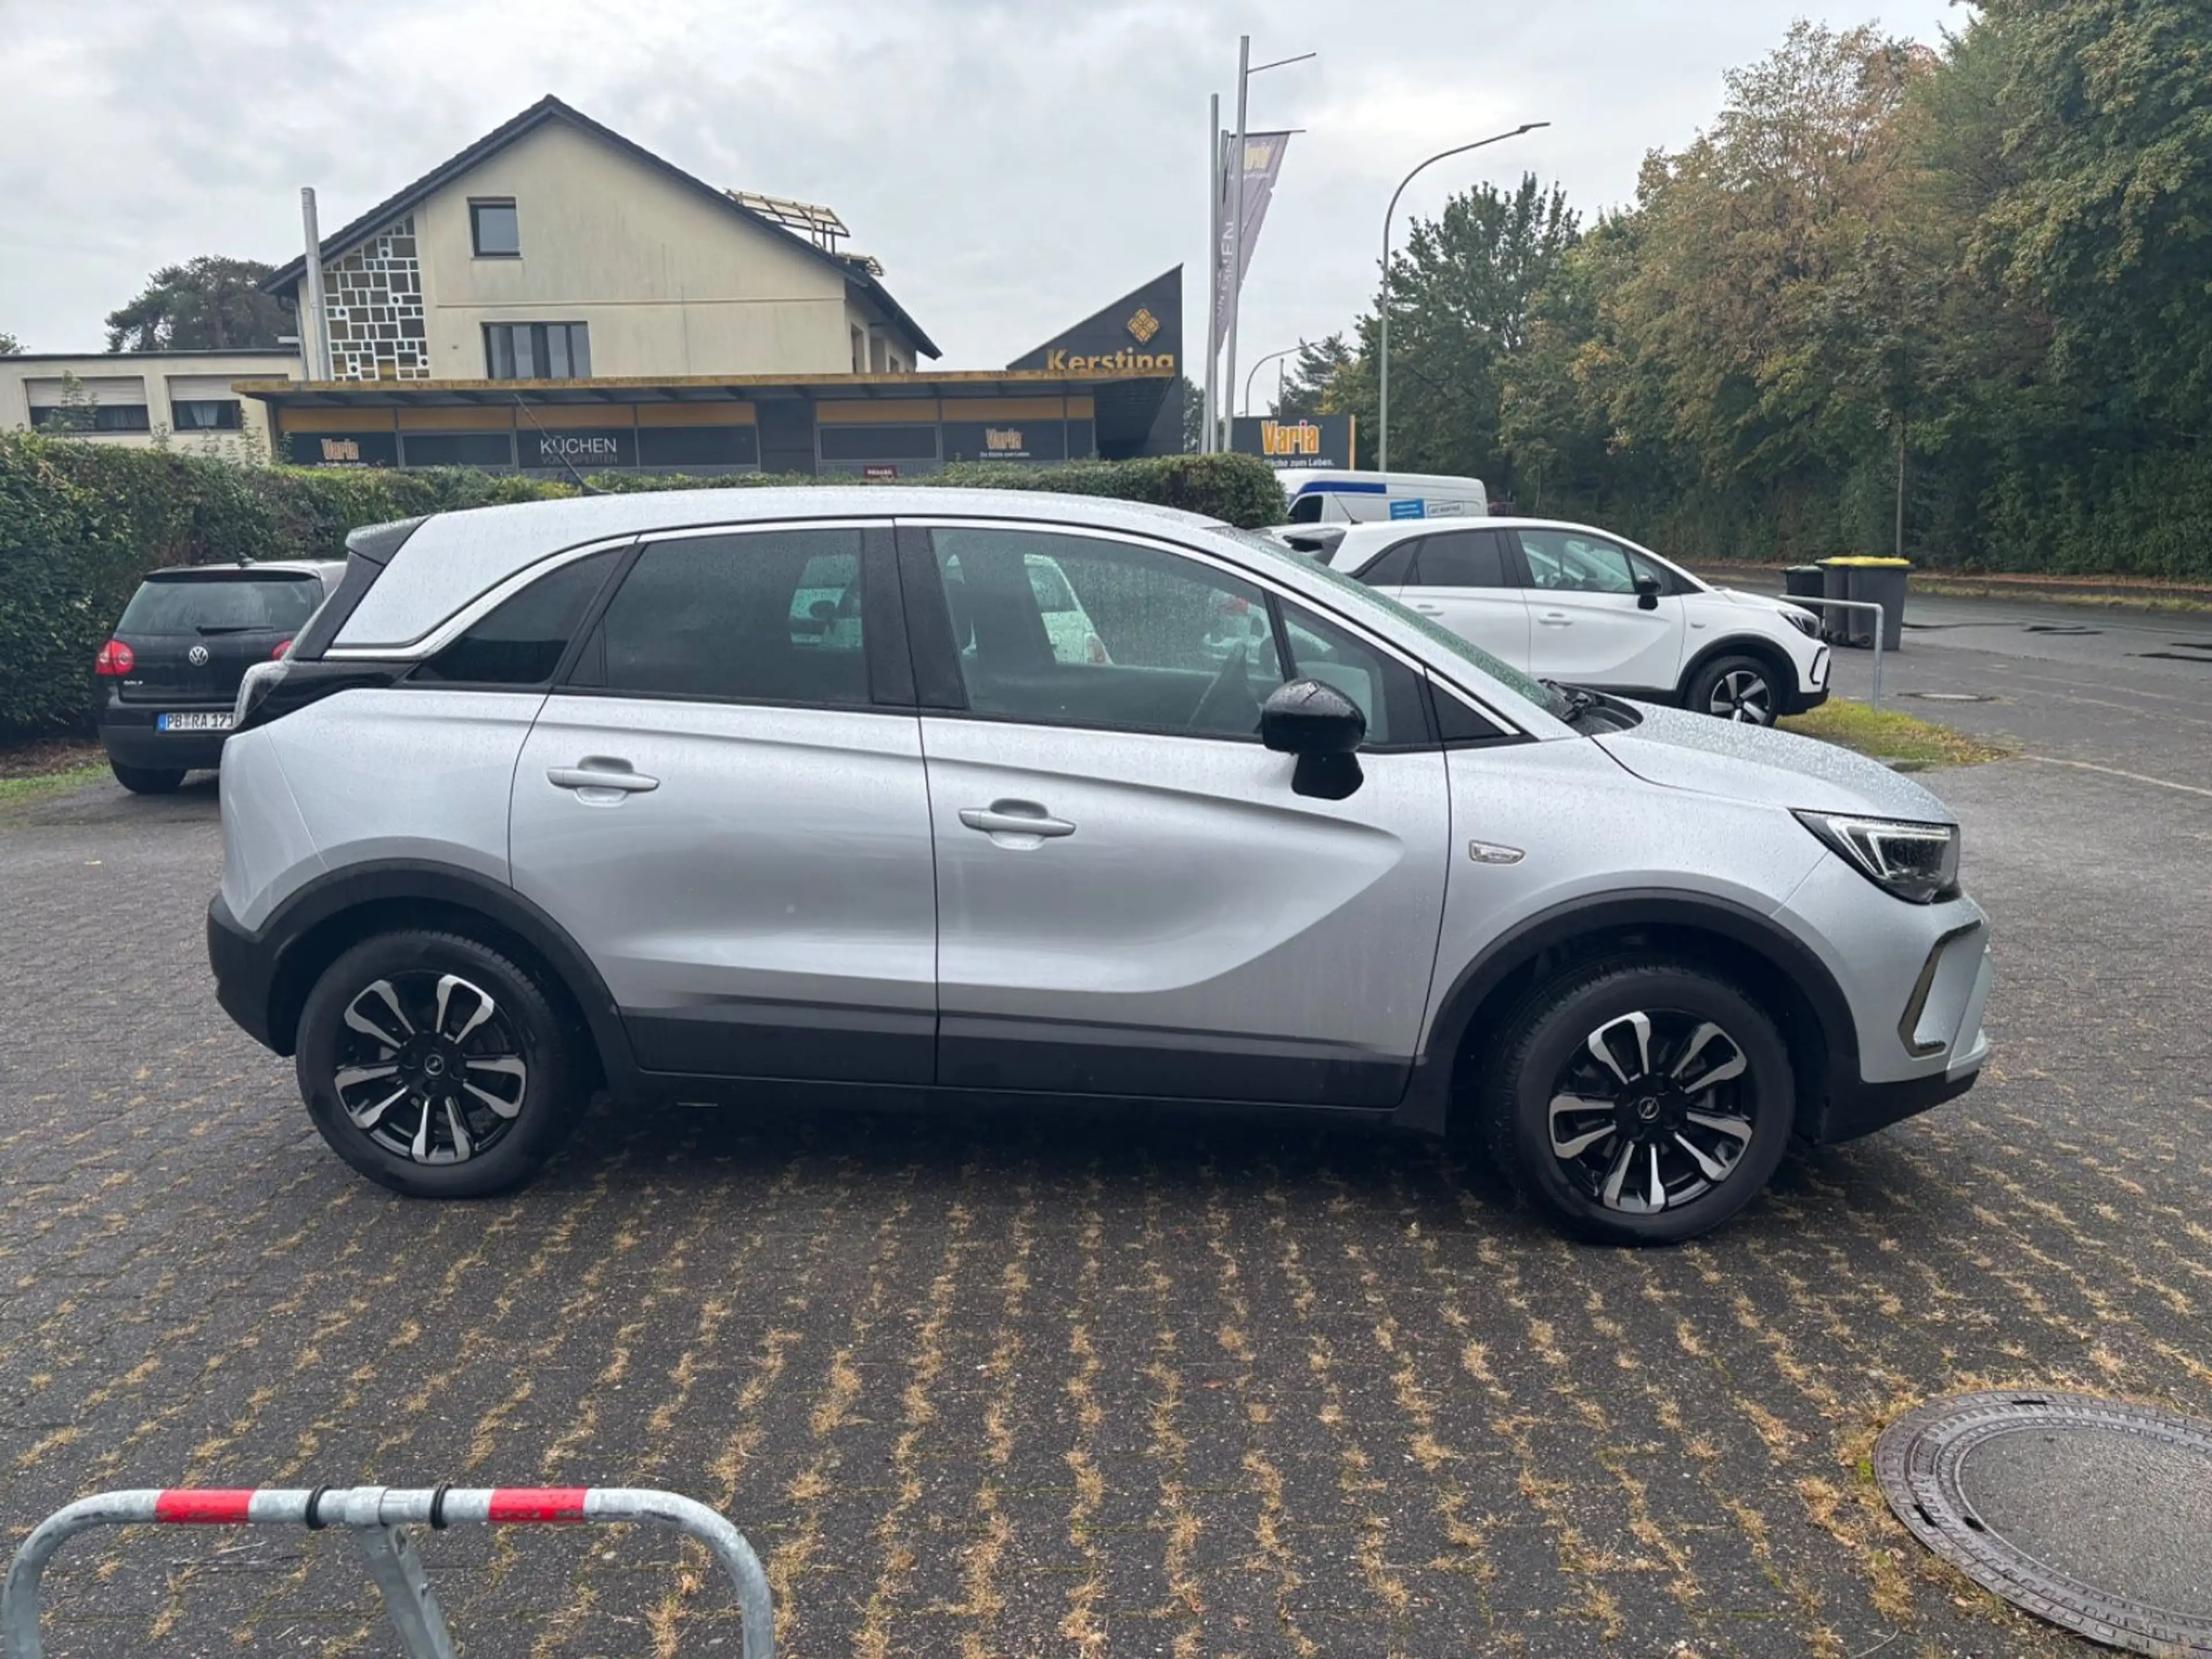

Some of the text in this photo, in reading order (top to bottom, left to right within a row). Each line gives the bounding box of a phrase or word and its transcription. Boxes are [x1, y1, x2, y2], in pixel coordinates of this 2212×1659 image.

[540, 435, 616, 454] KÜCHEN
[1261, 420, 1320, 454] Varia
[168, 714, 182, 728] PB
[192, 714, 207, 728] RA
